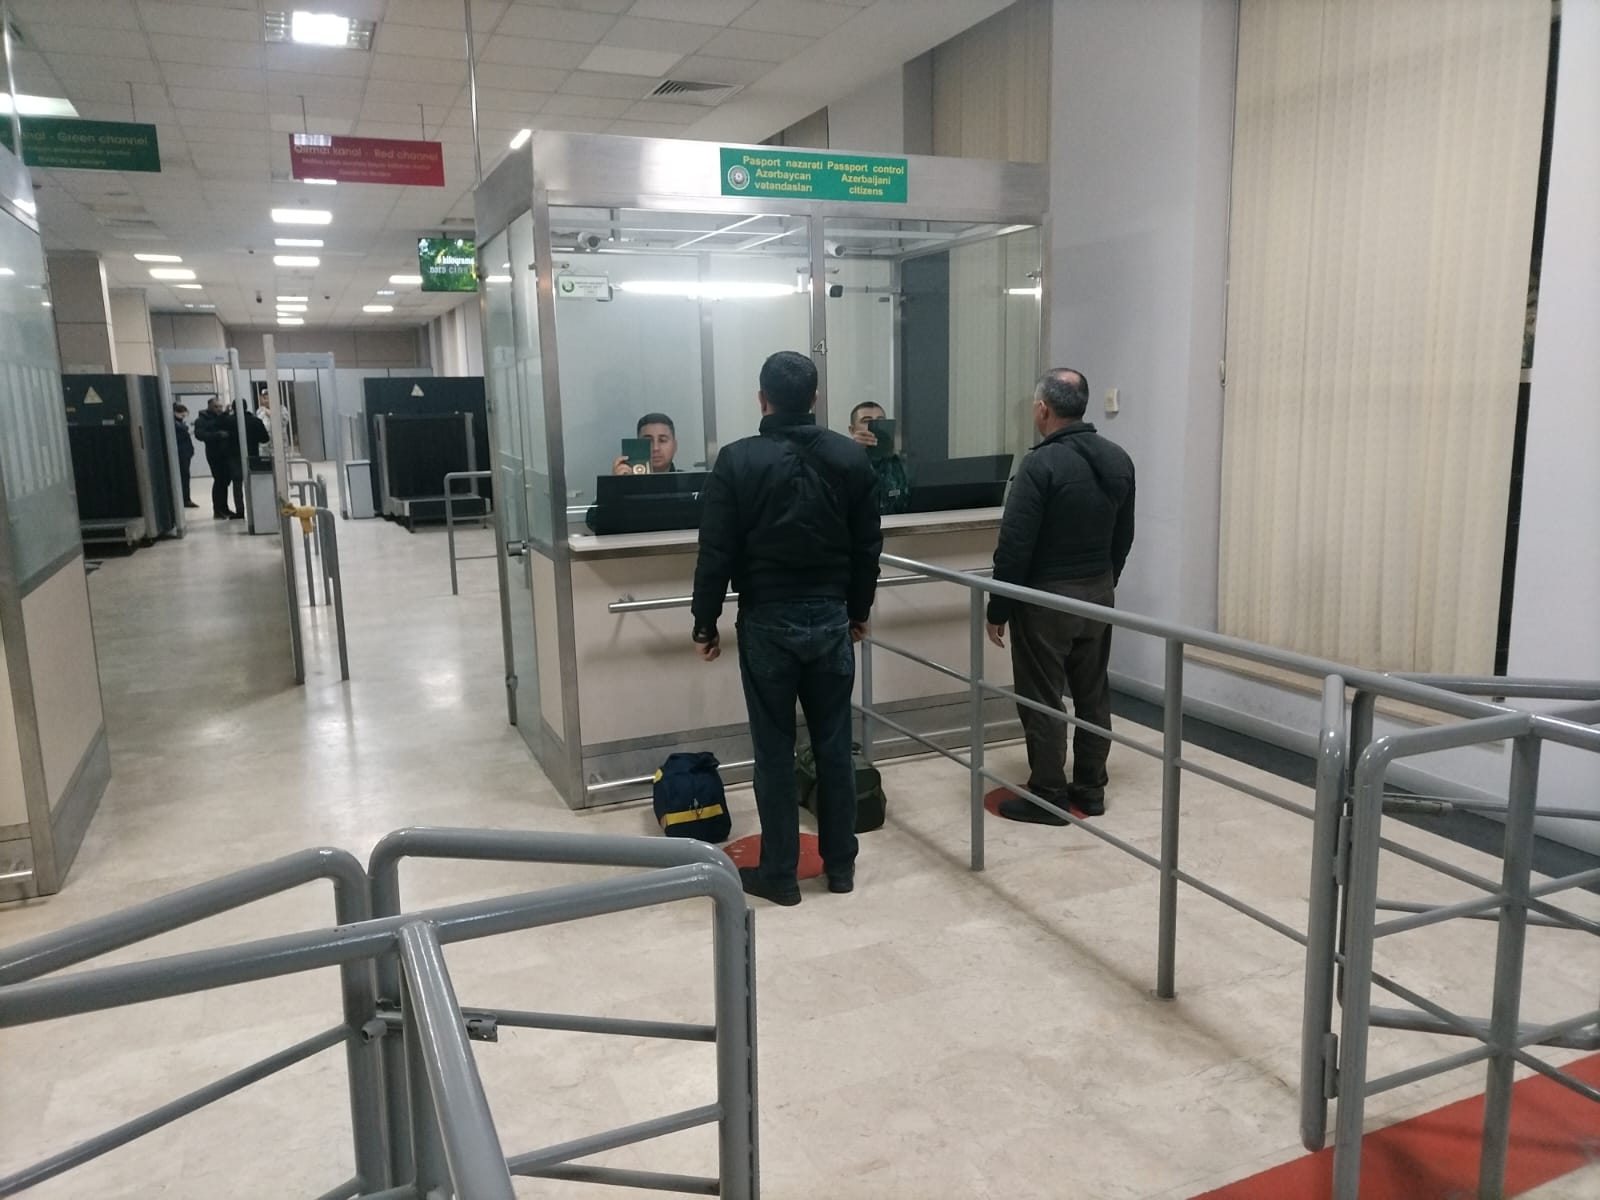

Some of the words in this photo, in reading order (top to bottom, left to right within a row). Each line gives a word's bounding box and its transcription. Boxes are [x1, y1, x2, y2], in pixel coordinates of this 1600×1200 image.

[57, 132, 95, 143] Green
[99, 134, 148, 145] channel
[374, 149, 394, 158] Red
[397, 150, 439, 161] channel
[743, 155, 781, 168] Pasport
[827, 161, 868, 173] Passport
[872, 165, 905, 175] control
[841, 173, 892, 187] Azerbaijani
[849, 186, 884, 197] citizens
[813, 338, 827, 356] 4
